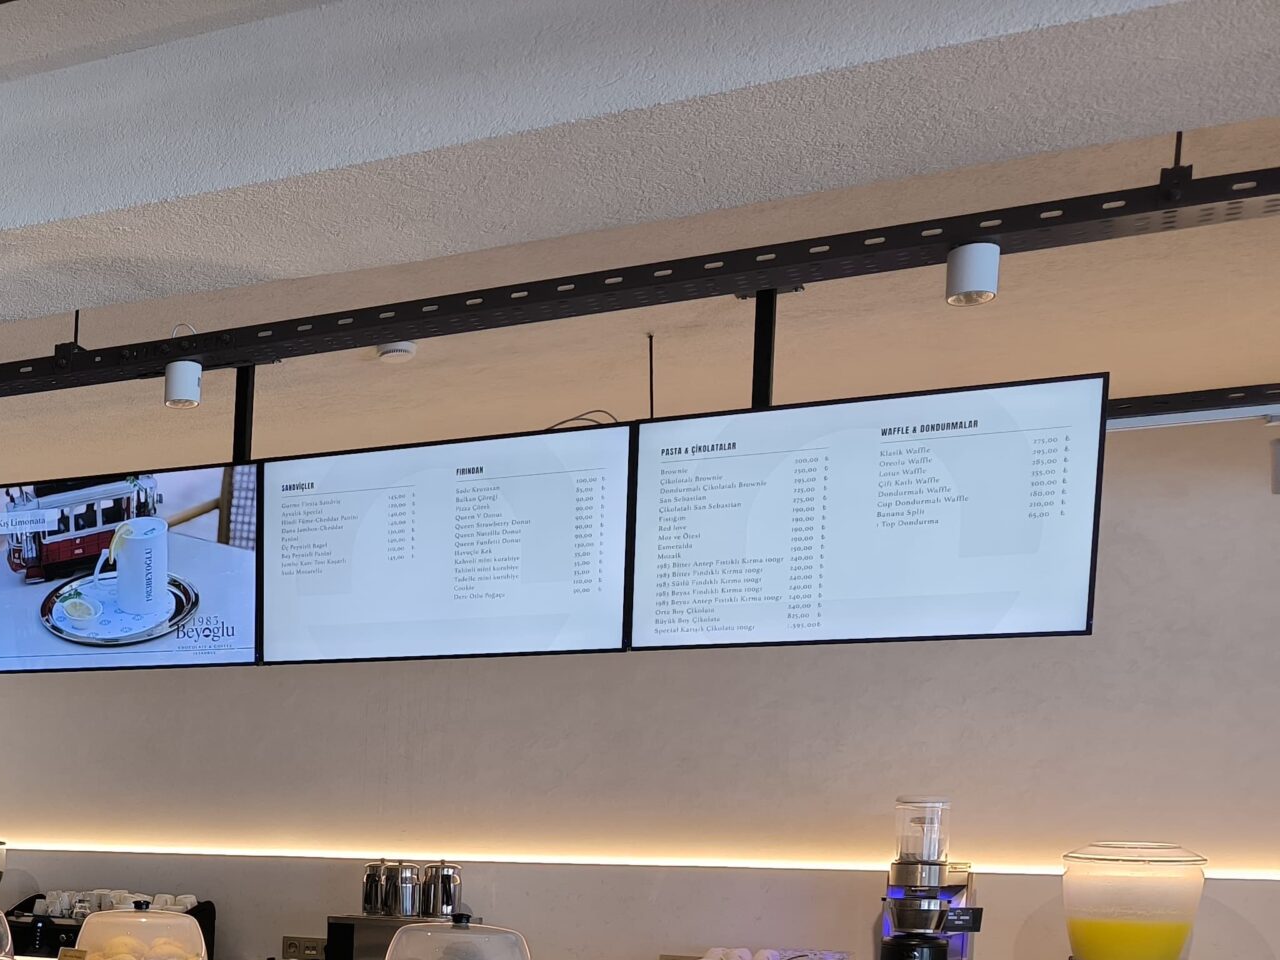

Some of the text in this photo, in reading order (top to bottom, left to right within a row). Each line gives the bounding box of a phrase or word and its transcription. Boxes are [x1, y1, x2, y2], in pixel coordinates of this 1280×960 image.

[880, 425, 909, 436] WAFFLE
[919, 419, 978, 433] DONDURMALAR
[660, 446, 682, 456] PASTA
[691, 439, 736, 456] ÇİKOLATALAR
[905, 445, 930, 455] Waffle
[908, 455, 932, 465] Waffle
[455, 465, 483, 476] FIRINDAN
[660, 467, 688, 475] Brownie
[902, 466, 927, 475] Waffle
[694, 473, 723, 482] Brownie
[915, 476, 939, 484] Waffle
[738, 479, 767, 488] Brownie
[926, 485, 952, 494] Waffle
[943, 494, 968, 503] Waffle
[876, 509, 904, 518] Banana
[10, 517, 46, 527] Limonata
[192, 615, 219, 626] 1983
